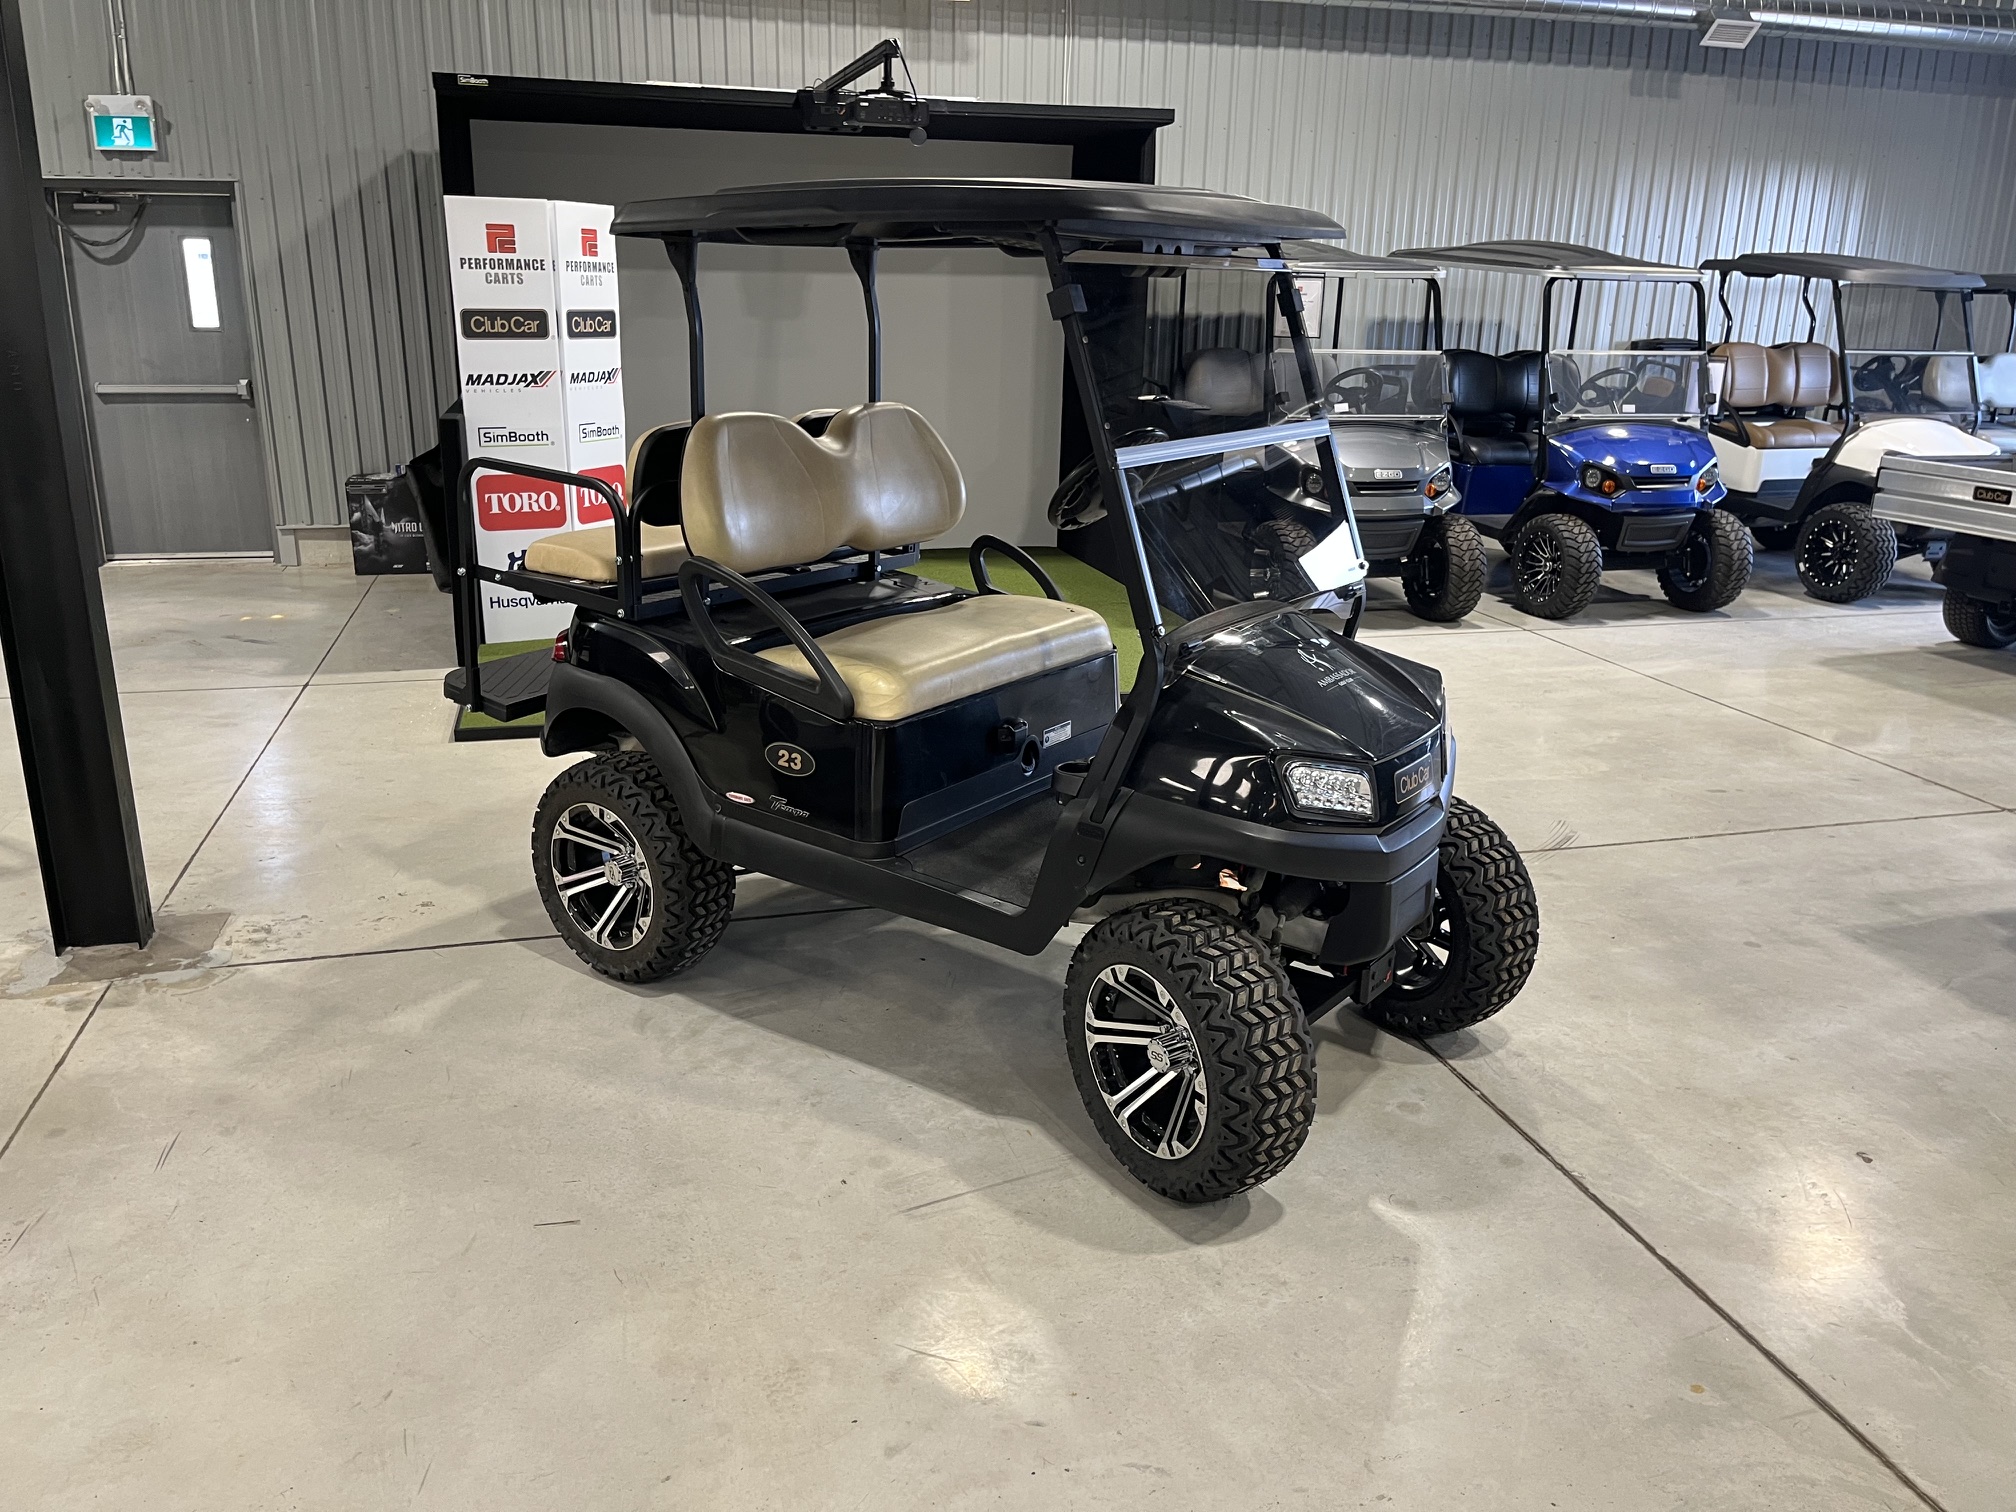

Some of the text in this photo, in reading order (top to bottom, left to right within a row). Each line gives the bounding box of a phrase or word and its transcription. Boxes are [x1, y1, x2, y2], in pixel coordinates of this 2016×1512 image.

[460, 257, 546, 271] PERFORMANCE
[565, 260, 615, 273] PERFORMANCE
[485, 272, 524, 285] CARTS
[580, 274, 603, 287] CARTS
[470, 316, 540, 333] Club Car
[572, 316, 612, 333] Club Car
[465, 371, 547, 388] MADJAX
[570, 367, 615, 385] MADJAX
[483, 431, 549, 443] SimBooth
[582, 426, 620, 439] SimBooth
[580, 482, 623, 508] TOO
[777, 749, 802, 770] 23
[1400, 766, 1430, 793] Club Car
